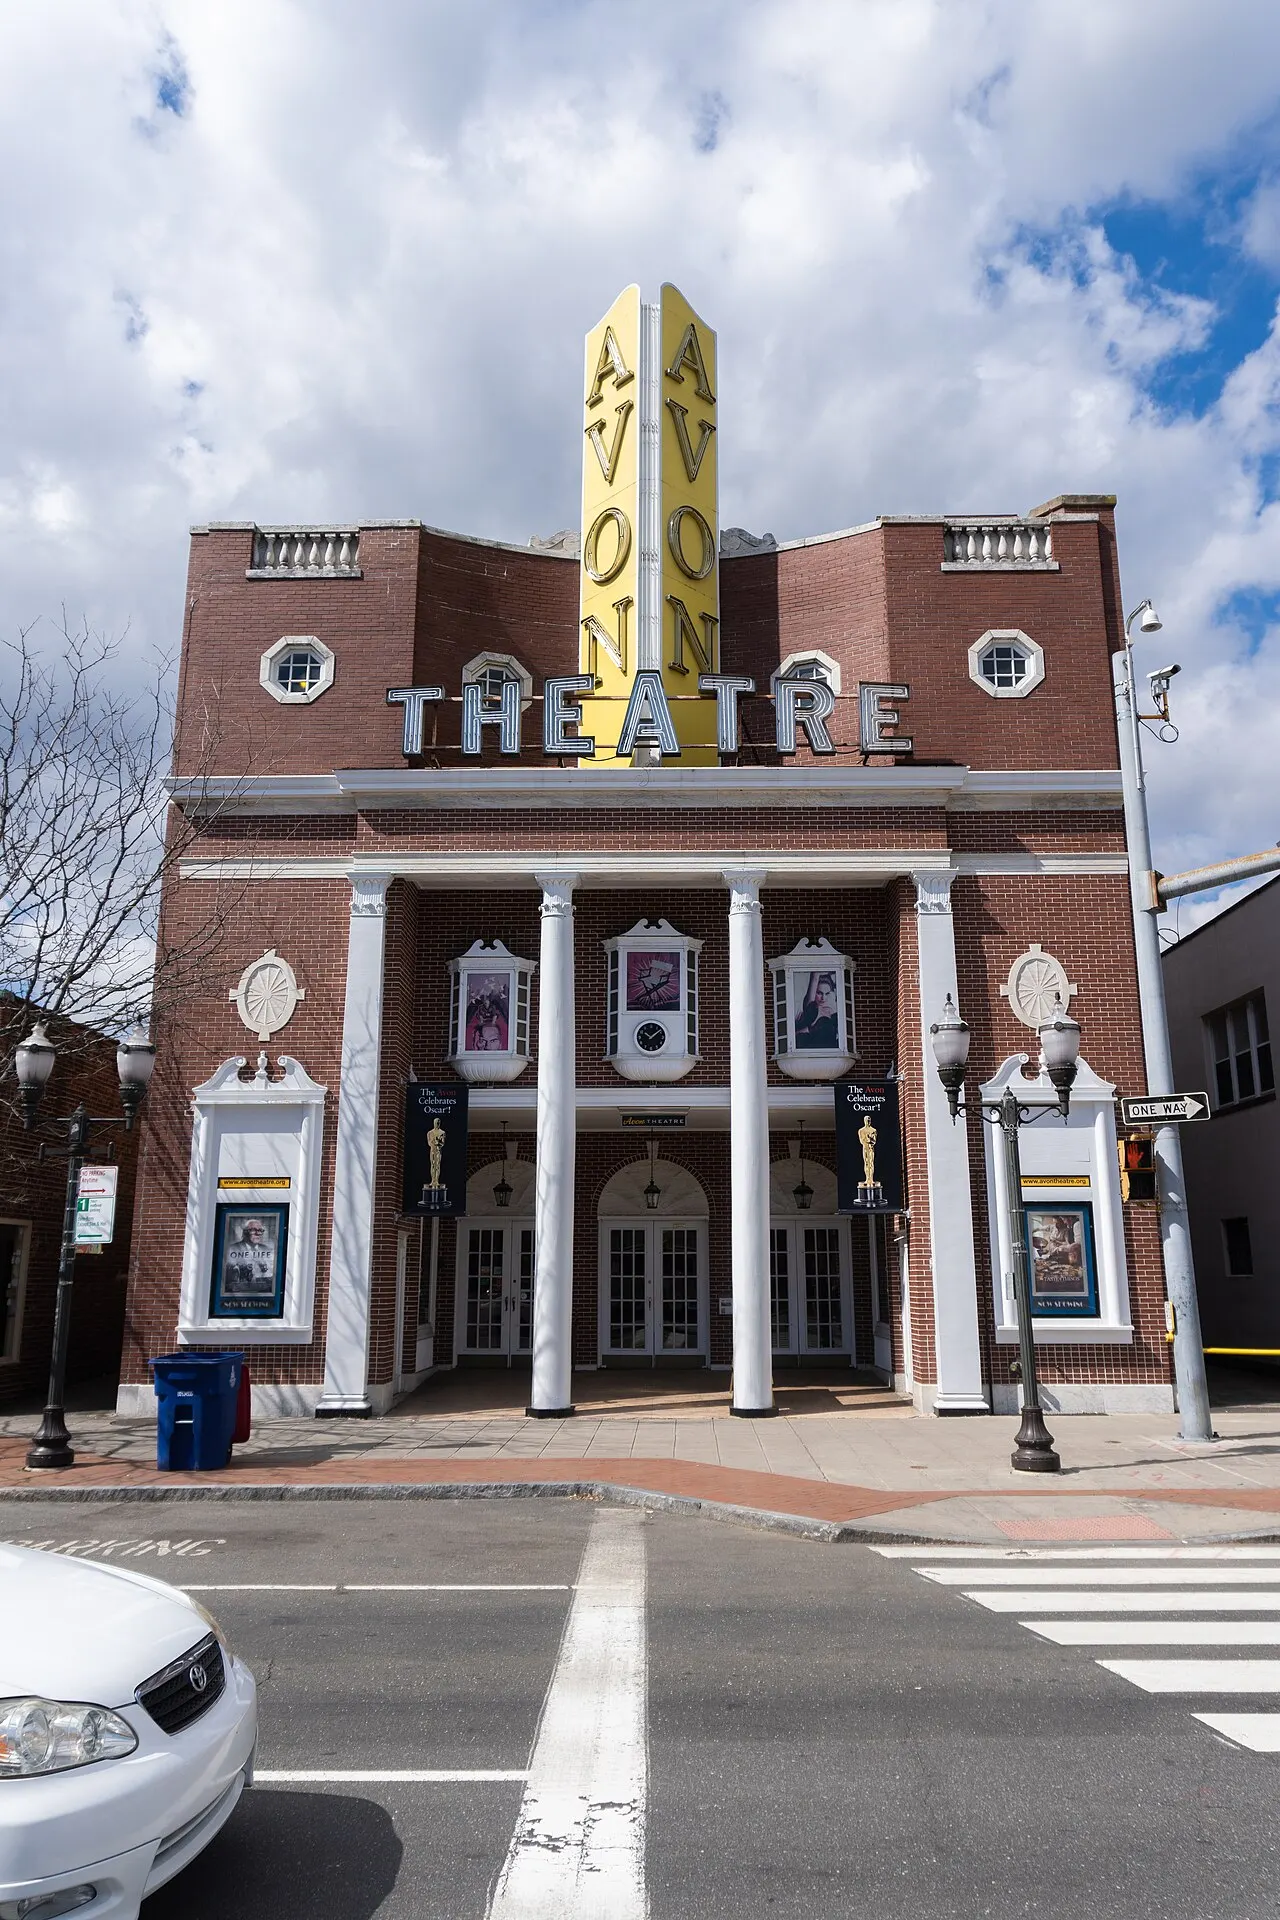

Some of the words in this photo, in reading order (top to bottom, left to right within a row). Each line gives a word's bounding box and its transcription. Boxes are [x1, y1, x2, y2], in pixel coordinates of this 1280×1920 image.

[665, 323, 719, 676] AVON
[581, 325, 635, 690] AVON
[386, 669, 914, 758] THEATRE
[420, 1088, 435, 1097] The
[437, 1088, 457, 1096] Avon
[848, 1085, 864, 1094] The
[865, 1085, 885, 1094] Avon
[418, 1096, 457, 1105] Celebrates
[846, 1094, 886, 1103] Celebrates
[1132, 1104, 1157, 1116] ONE
[1163, 1102, 1188, 1114] WAY
[623, 1116, 645, 1125] Avon
[223, 1179, 286, 1187] www.avontheatre.org
[1022, 1178, 1087, 1186] www.avontheatre.org
[80, 1198, 86, 1211] 1
[230, 1251, 249, 1259] ONE
